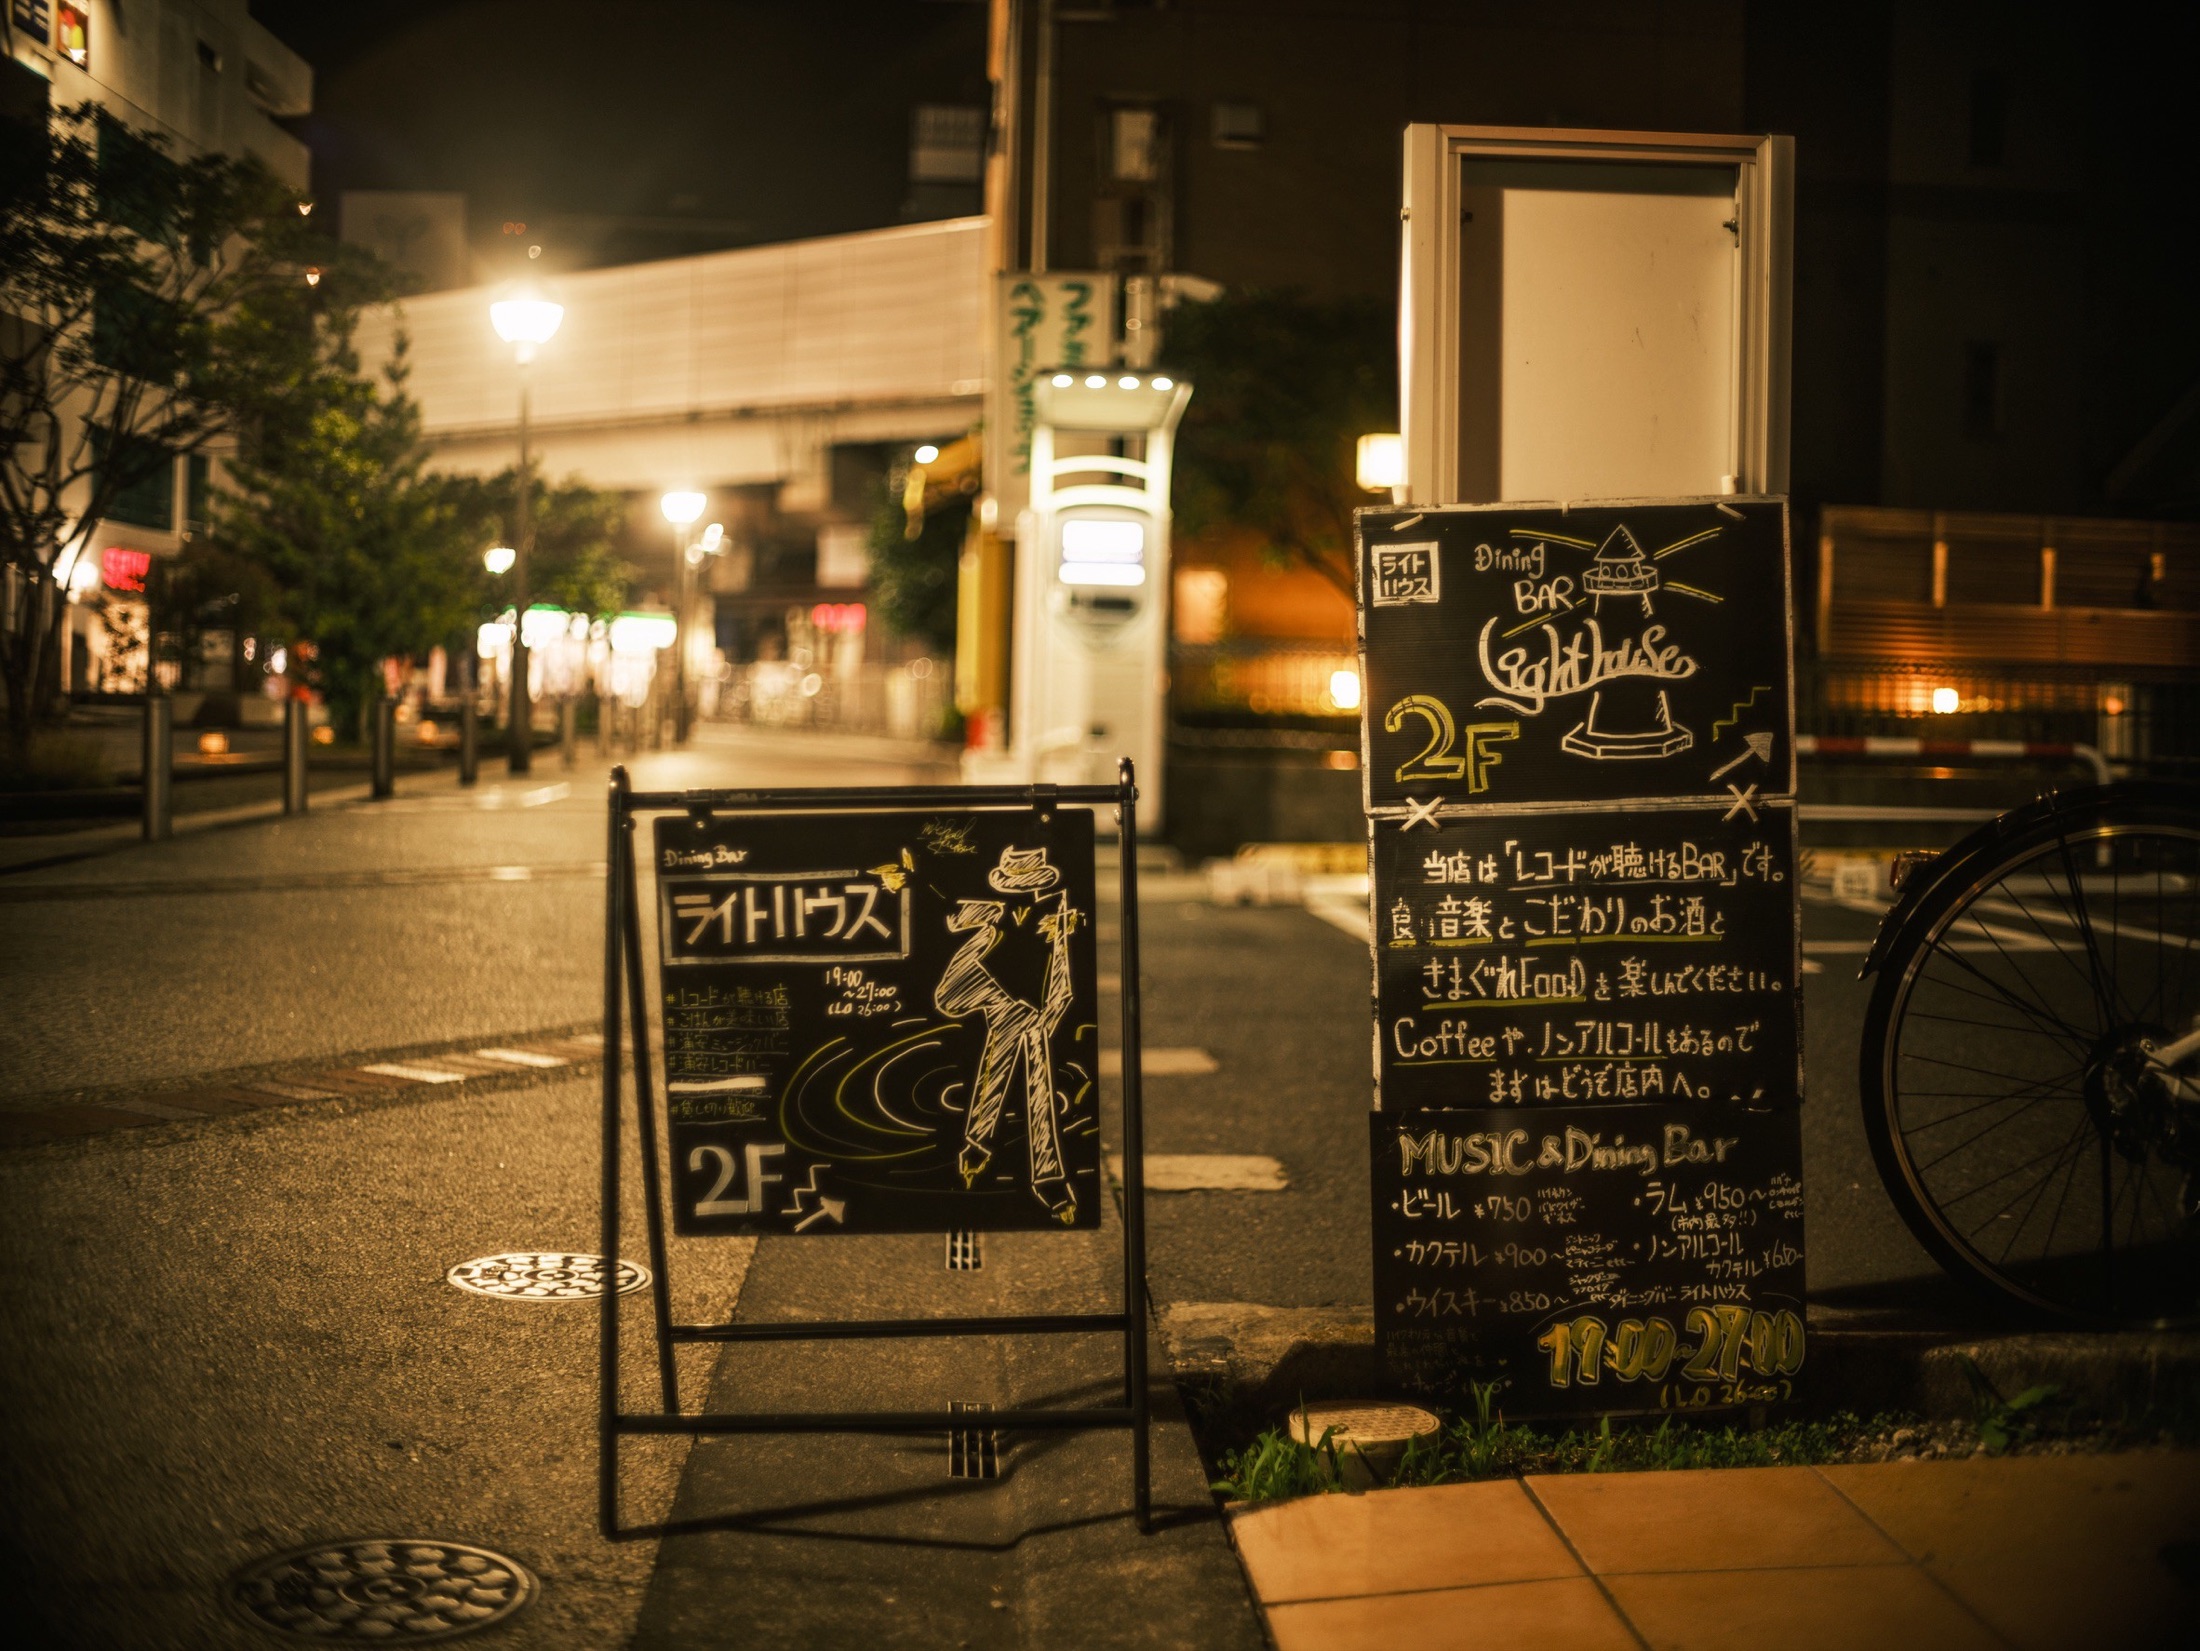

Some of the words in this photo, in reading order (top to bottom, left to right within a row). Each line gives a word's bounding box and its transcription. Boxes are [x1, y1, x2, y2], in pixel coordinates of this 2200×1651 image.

[1383, 553, 1426, 576] ライト
[1474, 541, 1546, 578] Dining
[1384, 577, 1431, 597] ハウス
[1514, 577, 1574, 613] BAR
[1385, 694, 1519, 793] 2F
[664, 849, 715, 870] Dining
[716, 846, 749, 864] Bar
[674, 884, 892, 946] ライトハウス
[825, 967, 863, 987] 19:00
[1399, 1129, 1533, 1176] MUSIC
[1664, 1124, 1739, 1167] Bar
[688, 1143, 786, 1217] 2F
[1681, 1283, 1751, 1301] ライトハウス
